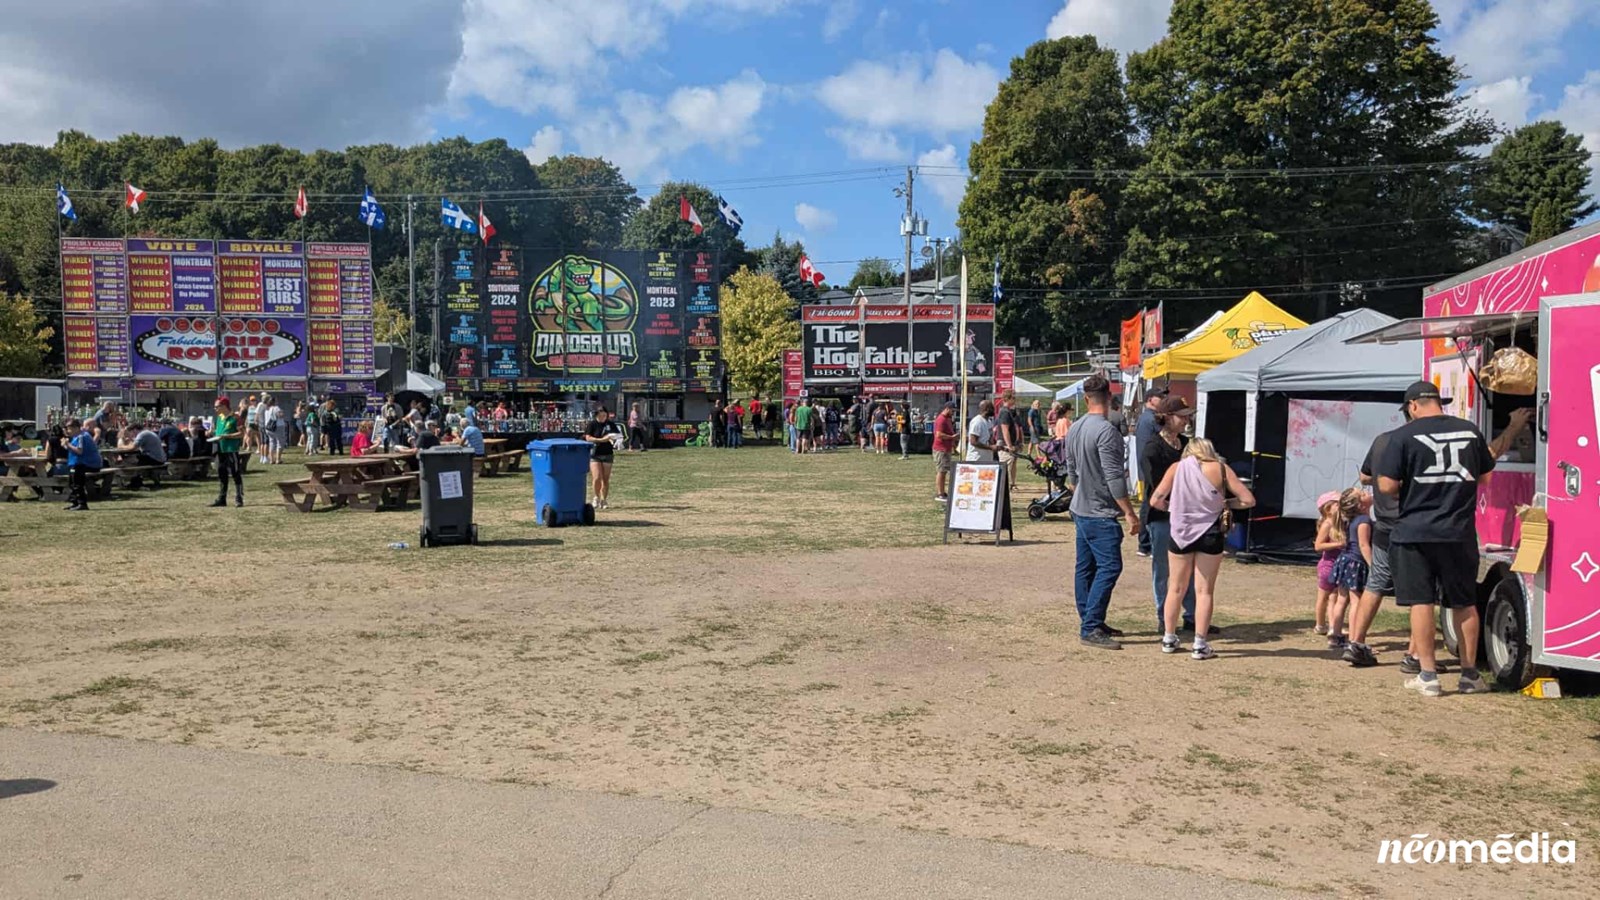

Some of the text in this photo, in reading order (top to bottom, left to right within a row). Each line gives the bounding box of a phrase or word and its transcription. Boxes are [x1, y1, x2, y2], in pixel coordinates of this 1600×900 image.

[146, 242, 196, 250] VOTE
[230, 244, 293, 252] ROYALE
[174, 258, 212, 266] MONTREAL
[265, 260, 302, 268] MONTREAL
[266, 278, 301, 291] BEST
[646, 286, 678, 294] MONTREAL
[267, 291, 301, 304] RIBS
[491, 294, 517, 305] 2024
[650, 297, 675, 307] 2023
[812, 325, 859, 343] The
[157, 336, 273, 347] Fabulous RIBS
[535, 333, 634, 357] DINOSAUR
[167, 347, 270, 360] ROYALE
[813, 347, 942, 368] Hogfather
[156, 380, 198, 389] RIBS
[205, 380, 282, 390] ROYALE
